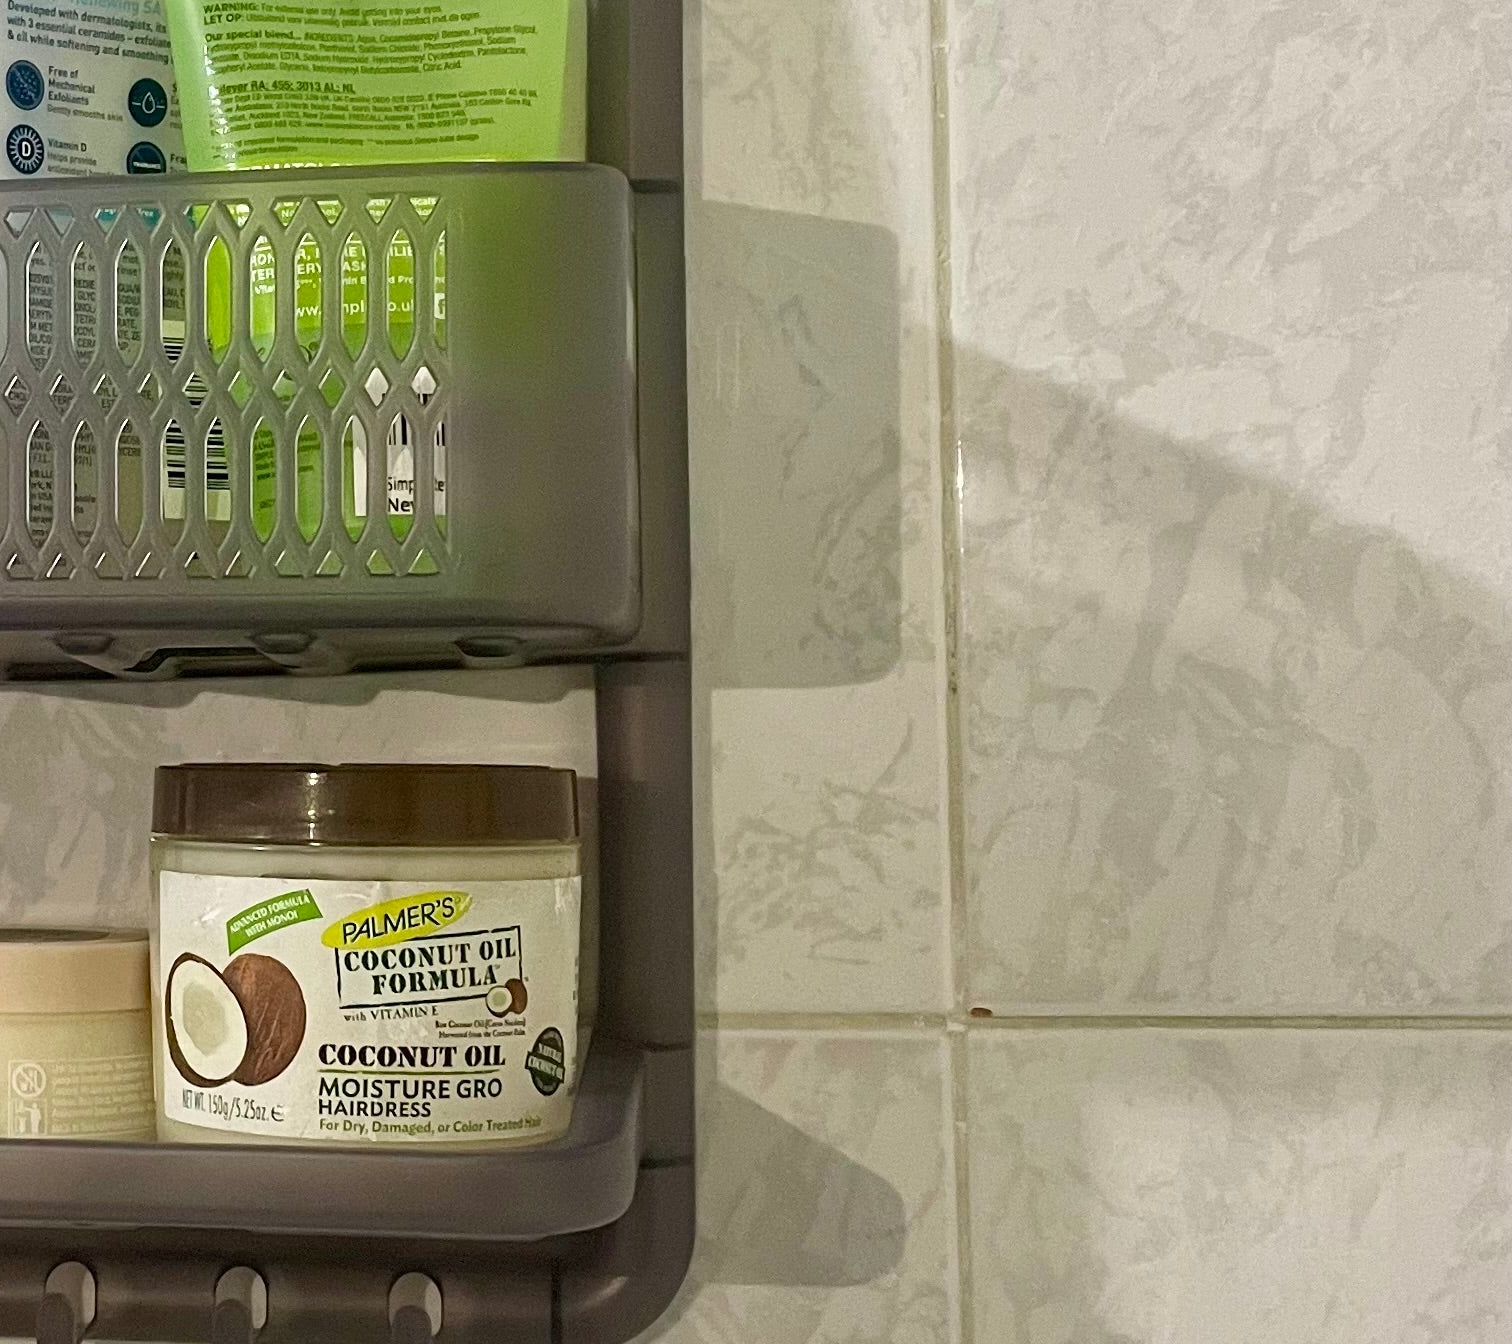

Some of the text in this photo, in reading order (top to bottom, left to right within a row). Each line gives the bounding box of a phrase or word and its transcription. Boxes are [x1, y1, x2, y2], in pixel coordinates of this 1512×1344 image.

[7, 0, 56, 17] Developed
[58, 9, 79, 20] with
[204, 3, 259, 14] WARNING:
[7, 16, 27, 27] with
[28, 18, 34, 28] 3
[35, 21, 76, 34] essential
[78, 27, 126, 42] ceramides
[204, 14, 222, 26] LET
[205, 31, 224, 43] Our
[226, 30, 262, 41] special
[7, 30, 169, 66] & oil while softening and smoothing
[48, 66, 79, 78] Free of
[48, 79, 96, 94] Mechanical
[22, 142, 31, 157] D
[48, 138, 87, 151] Vitamin D
[269, 895, 310, 914] FORMULA
[343, 897, 455, 944] PALMER'S
[344, 937, 516, 972] COCONUT OIL
[372, 964, 498, 995] FORMULA
[344, 1006, 438, 1022] with VITAMIN E
[318, 1043, 458, 1068] COCONUT
[464, 1045, 505, 1067] OIL
[318, 1077, 503, 1099] MOISTURE GRO
[183, 1088, 192, 1109] NET
[318, 1099, 431, 1117] HAIRDRESS
[319, 1119, 339, 1130] For
[343, 1121, 369, 1135] Dry,
[372, 1121, 435, 1136] Damaged,
[437, 1124, 450, 1133] or
[453, 1120, 483, 1132] Color
[487, 1118, 523, 1131] Treated
